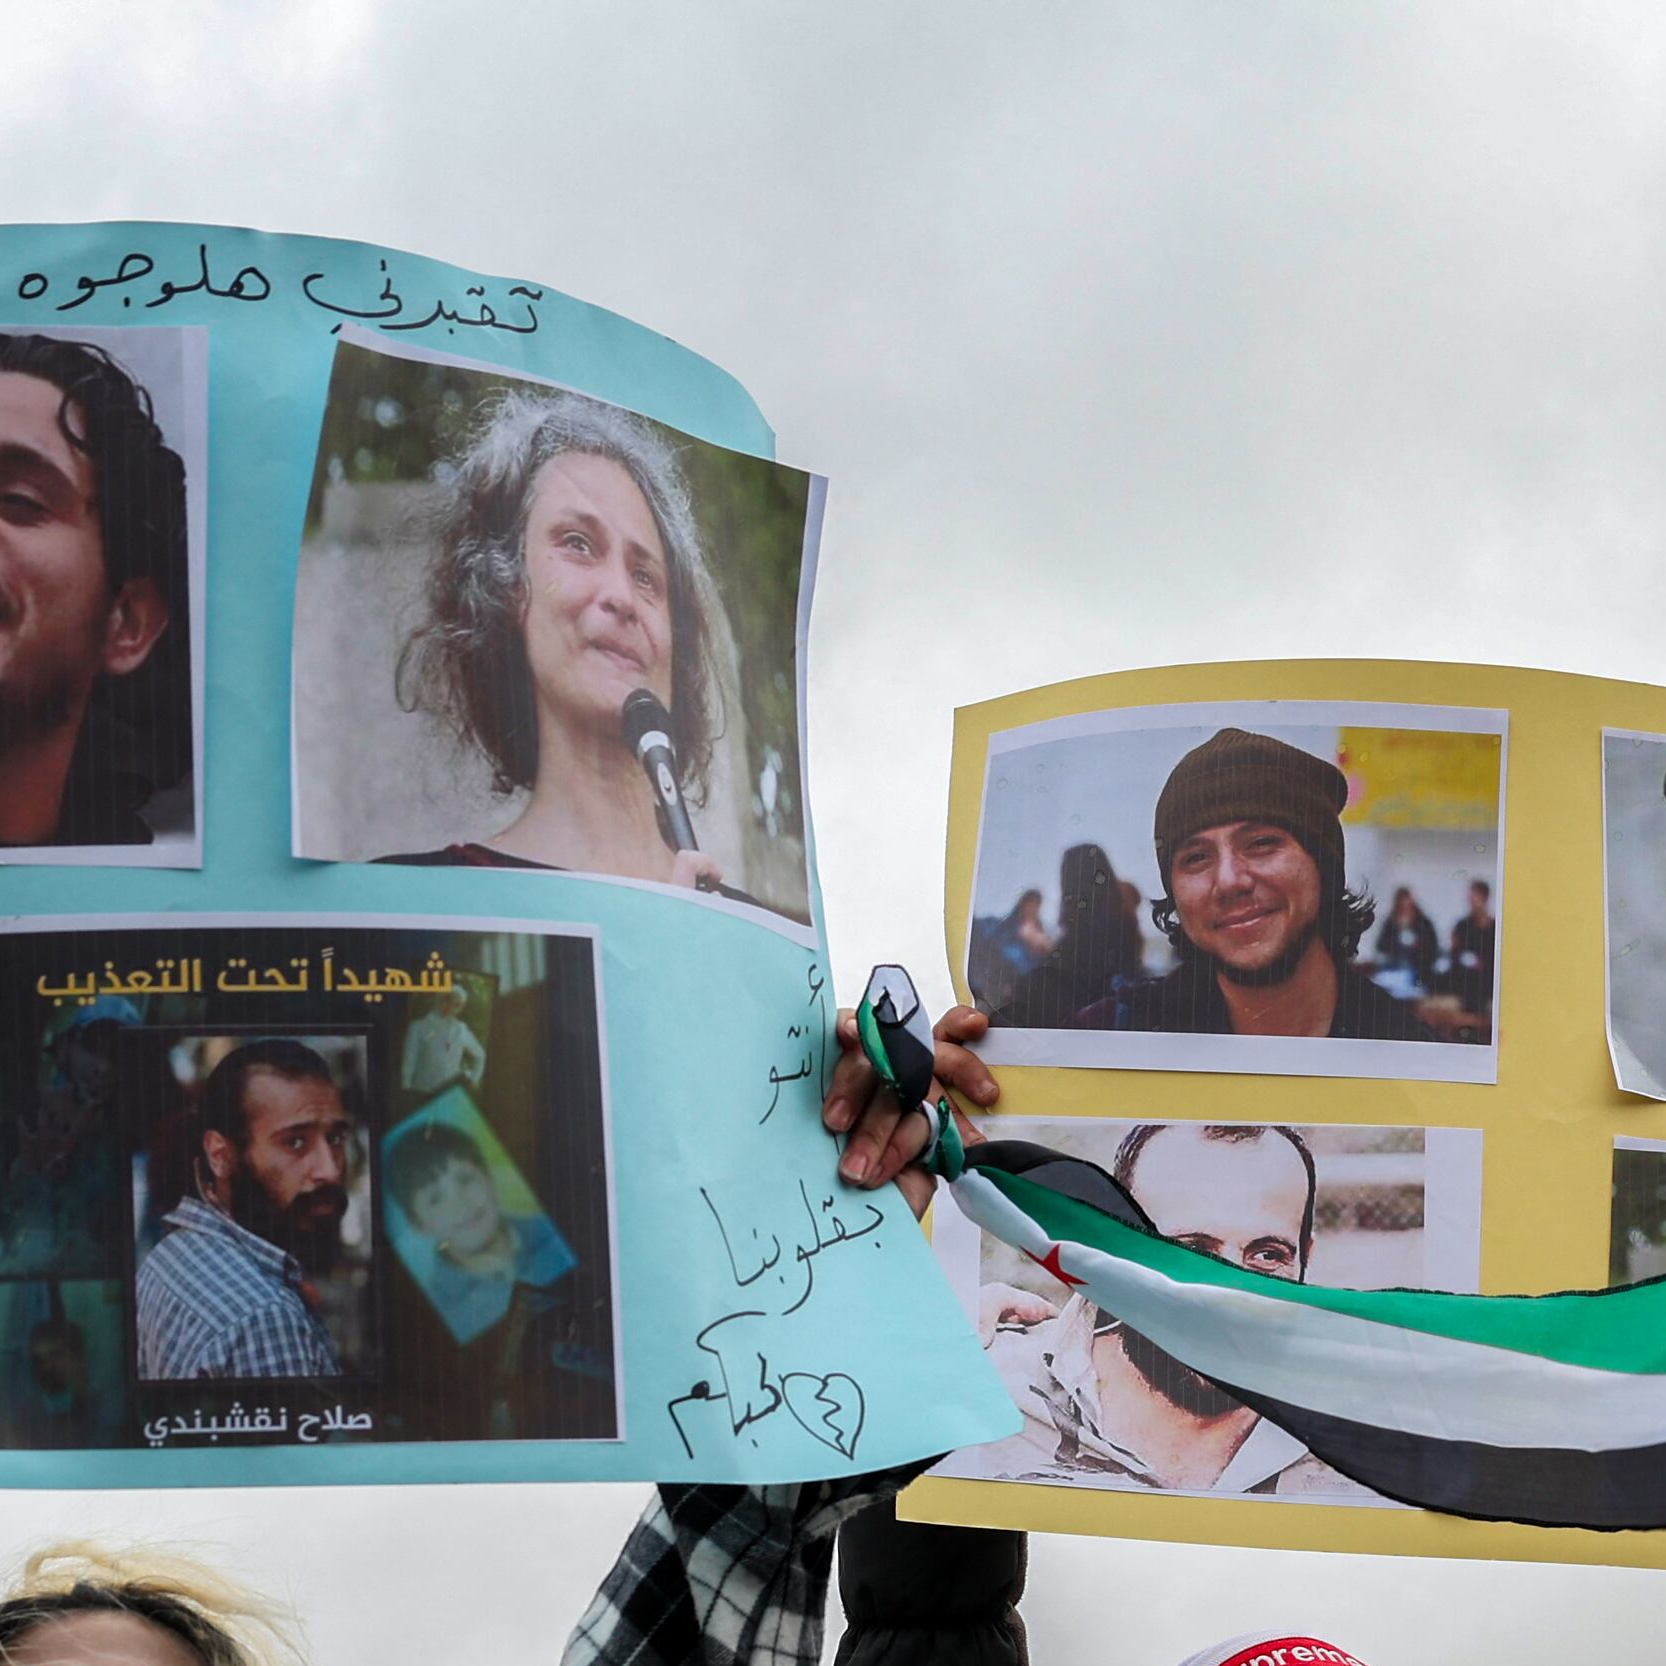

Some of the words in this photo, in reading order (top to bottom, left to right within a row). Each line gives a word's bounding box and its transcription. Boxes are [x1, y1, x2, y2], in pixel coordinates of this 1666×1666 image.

[36, 958, 202, 1007] التعذيب
[217, 957, 309, 993] تحت
[699, 1178, 885, 1316] بقلوبنا
[142, 1401, 288, 1447] نقشبندي
[298, 1404, 374, 1441] صلاح
